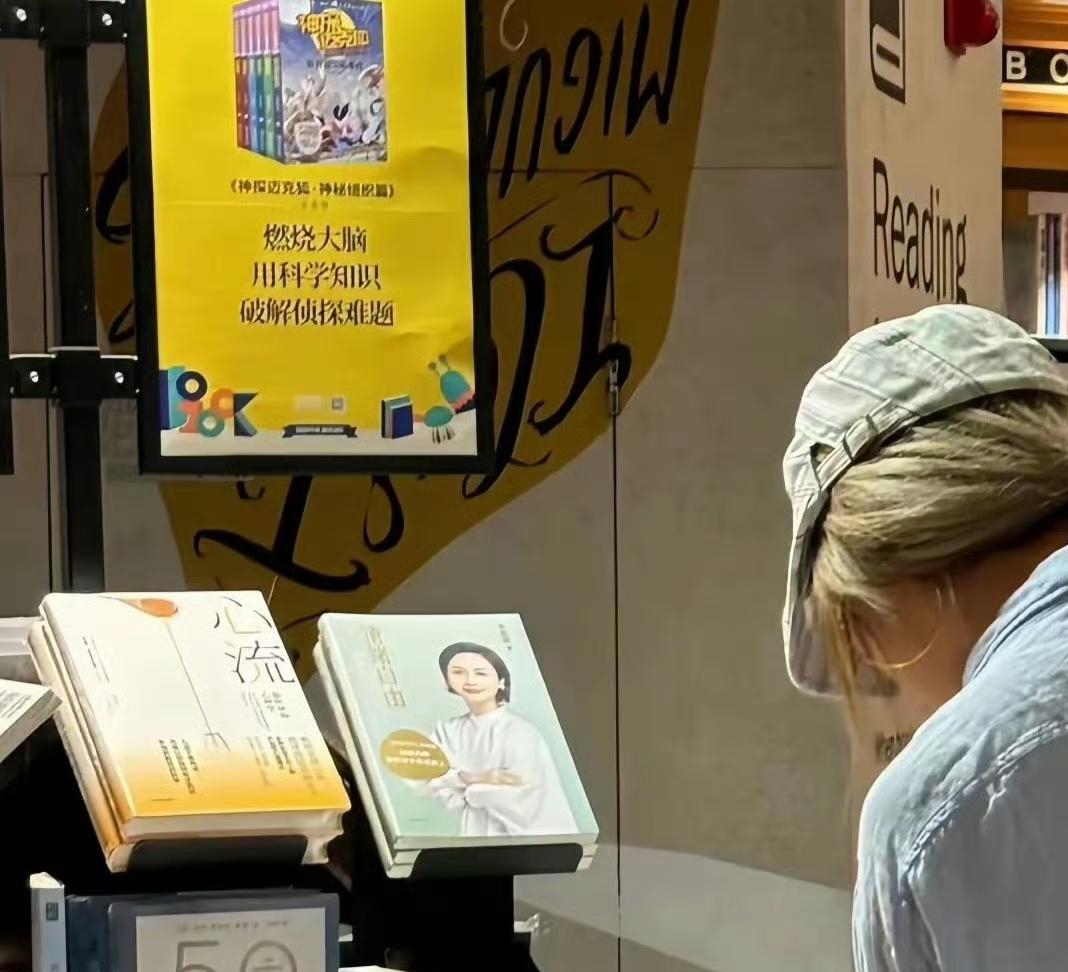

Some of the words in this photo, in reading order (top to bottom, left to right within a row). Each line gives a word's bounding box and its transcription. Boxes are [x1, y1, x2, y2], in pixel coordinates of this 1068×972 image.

[263, 223, 367, 253] 燃烧大脑
[872, 156, 968, 304] Reading
[252, 261, 382, 290] 用科学知识
[240, 297, 394, 326] 破解侦探难题
